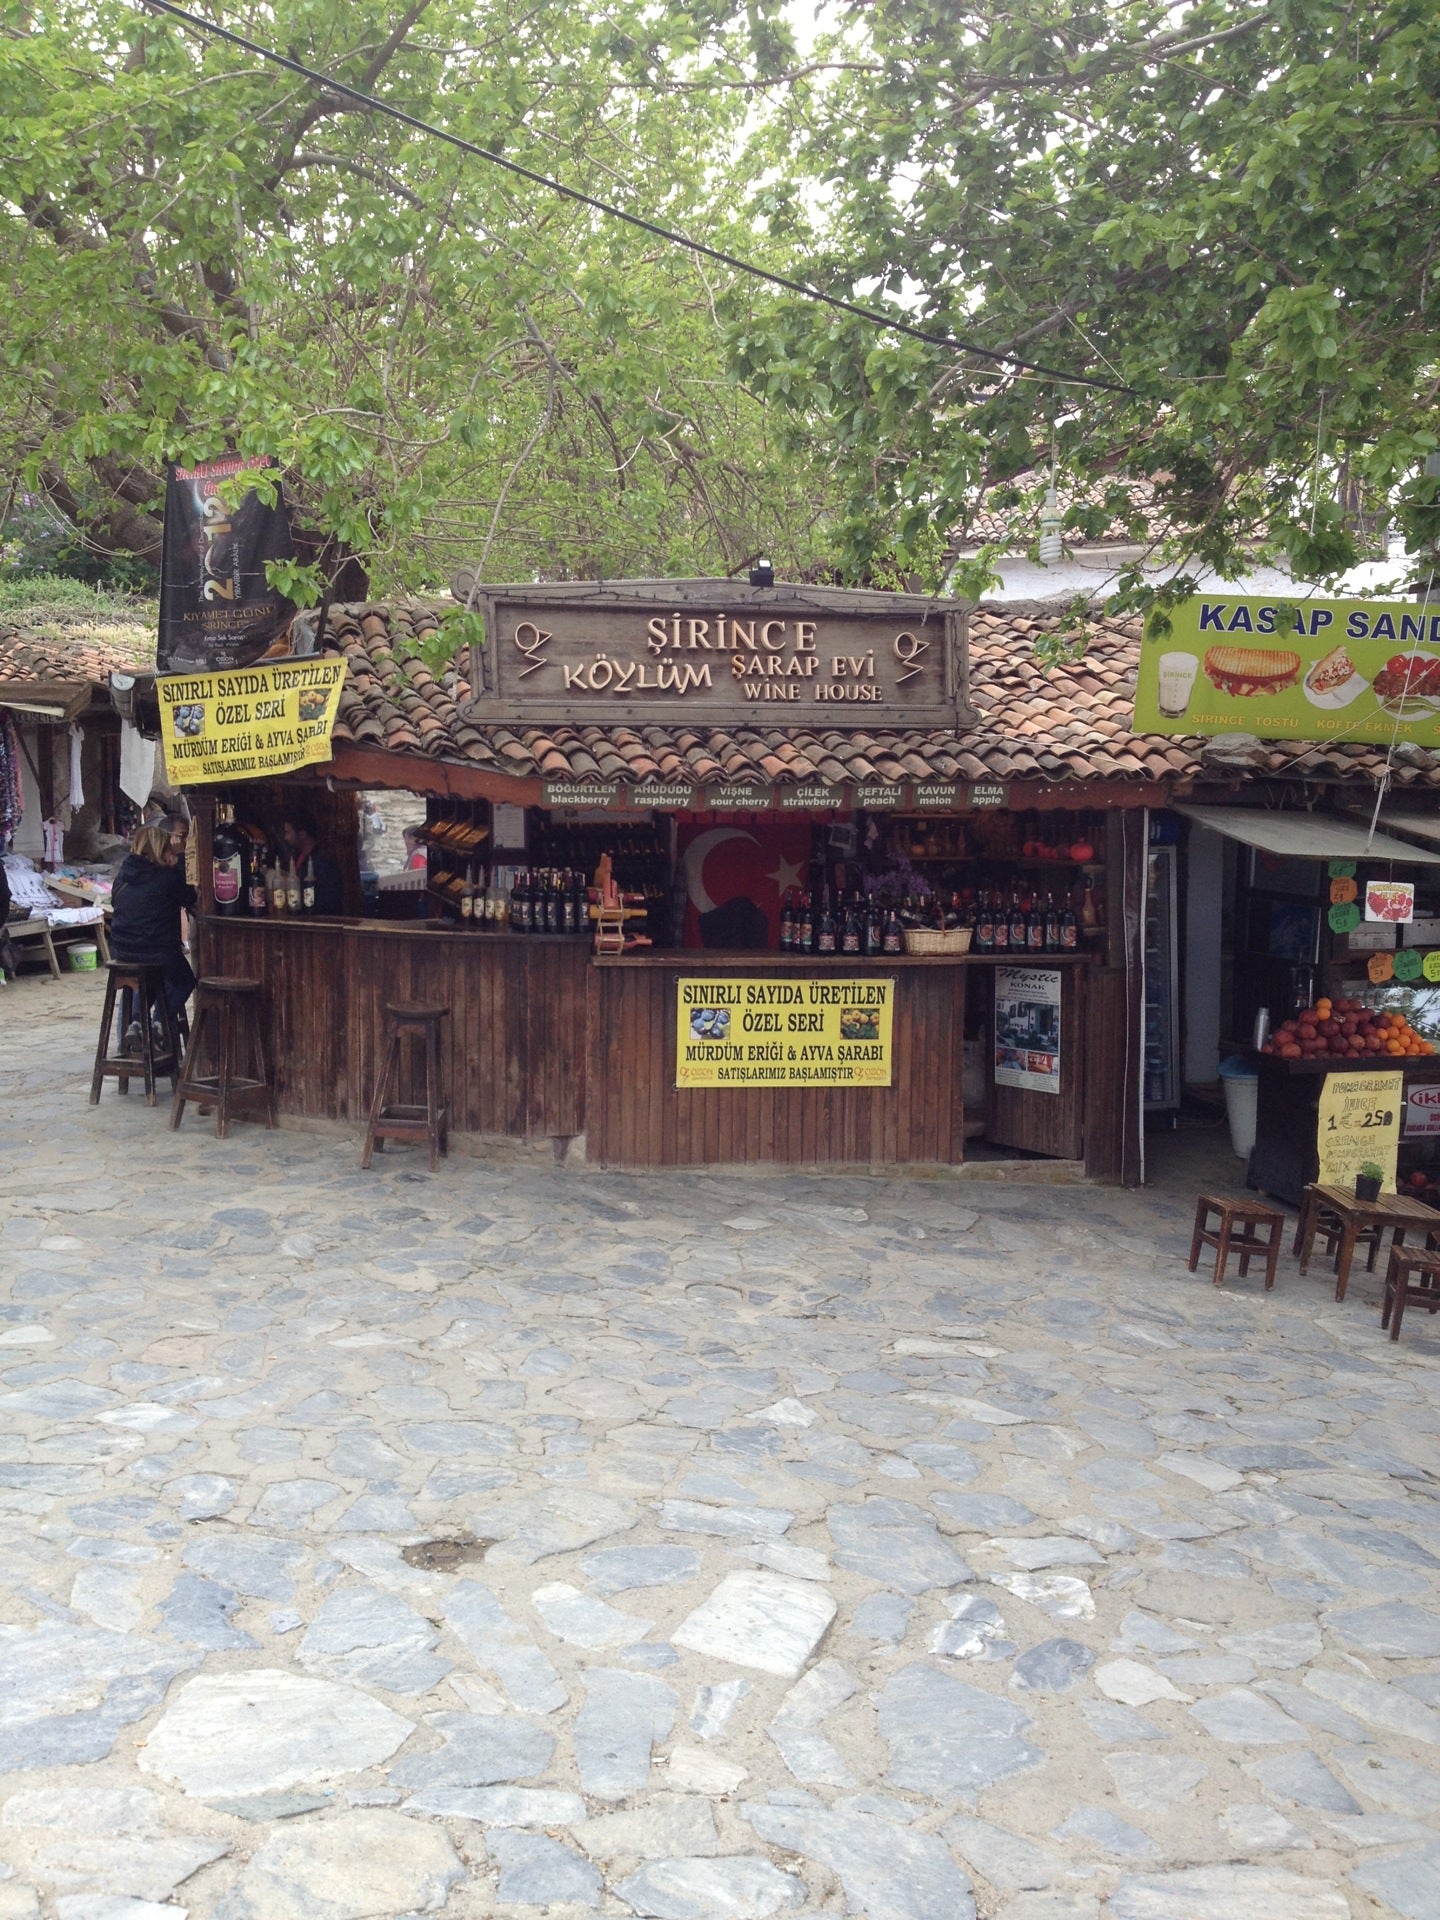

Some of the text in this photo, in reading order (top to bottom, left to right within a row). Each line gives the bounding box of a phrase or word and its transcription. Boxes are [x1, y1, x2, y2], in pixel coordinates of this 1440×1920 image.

[647, 611, 818, 656] ŞİRİNCE
[731, 648, 875, 680] ŞARAP EVİ
[562, 652, 713, 695] KÖYLÜM
[162, 663, 342, 703] SINIRLI SAYIDA ÜRETİLEN
[814, 683, 883, 702] HOUSE
[215, 693, 286, 726] ÖZEL SERİ
[1255, 716, 1300, 728] TOSTU
[1364, 721, 1413, 733] EKMEK
[172, 735, 218, 760] MÜRDÜM
[221, 731, 252, 754] ERİĞİ
[255, 733, 264, 750] &
[266, 730, 294, 749] AYVA
[202, 755, 257, 777] SATIŞLARIMIZ
[634, 785, 692, 795] AHUDUDU
[917, 785, 956, 796] KAVUN
[973, 785, 1004, 796] ELMA
[551, 794, 610, 806] blackberry
[634, 795, 690, 807] raspberry
[710, 797, 770, 808] sour cherry
[783, 797, 842, 808] strawberry
[863, 797, 896, 807] peach
[919, 796, 952, 806] melon
[972, 795, 1002, 806] apple
[998, 967, 1059, 984] Mystic
[683, 981, 887, 1005] SINIRLI SAYIDA ÜRETİLEN
[1010, 981, 1045, 991] KONAK
[742, 1008, 825, 1032] ÖZEL SERİ
[685, 1041, 884, 1065] MÜRDÜM ERİĞİ & AYVA ŞARABI
[717, 1066, 854, 1083] SATIŞLARIMIZ BAŞLAMIŞTIR
